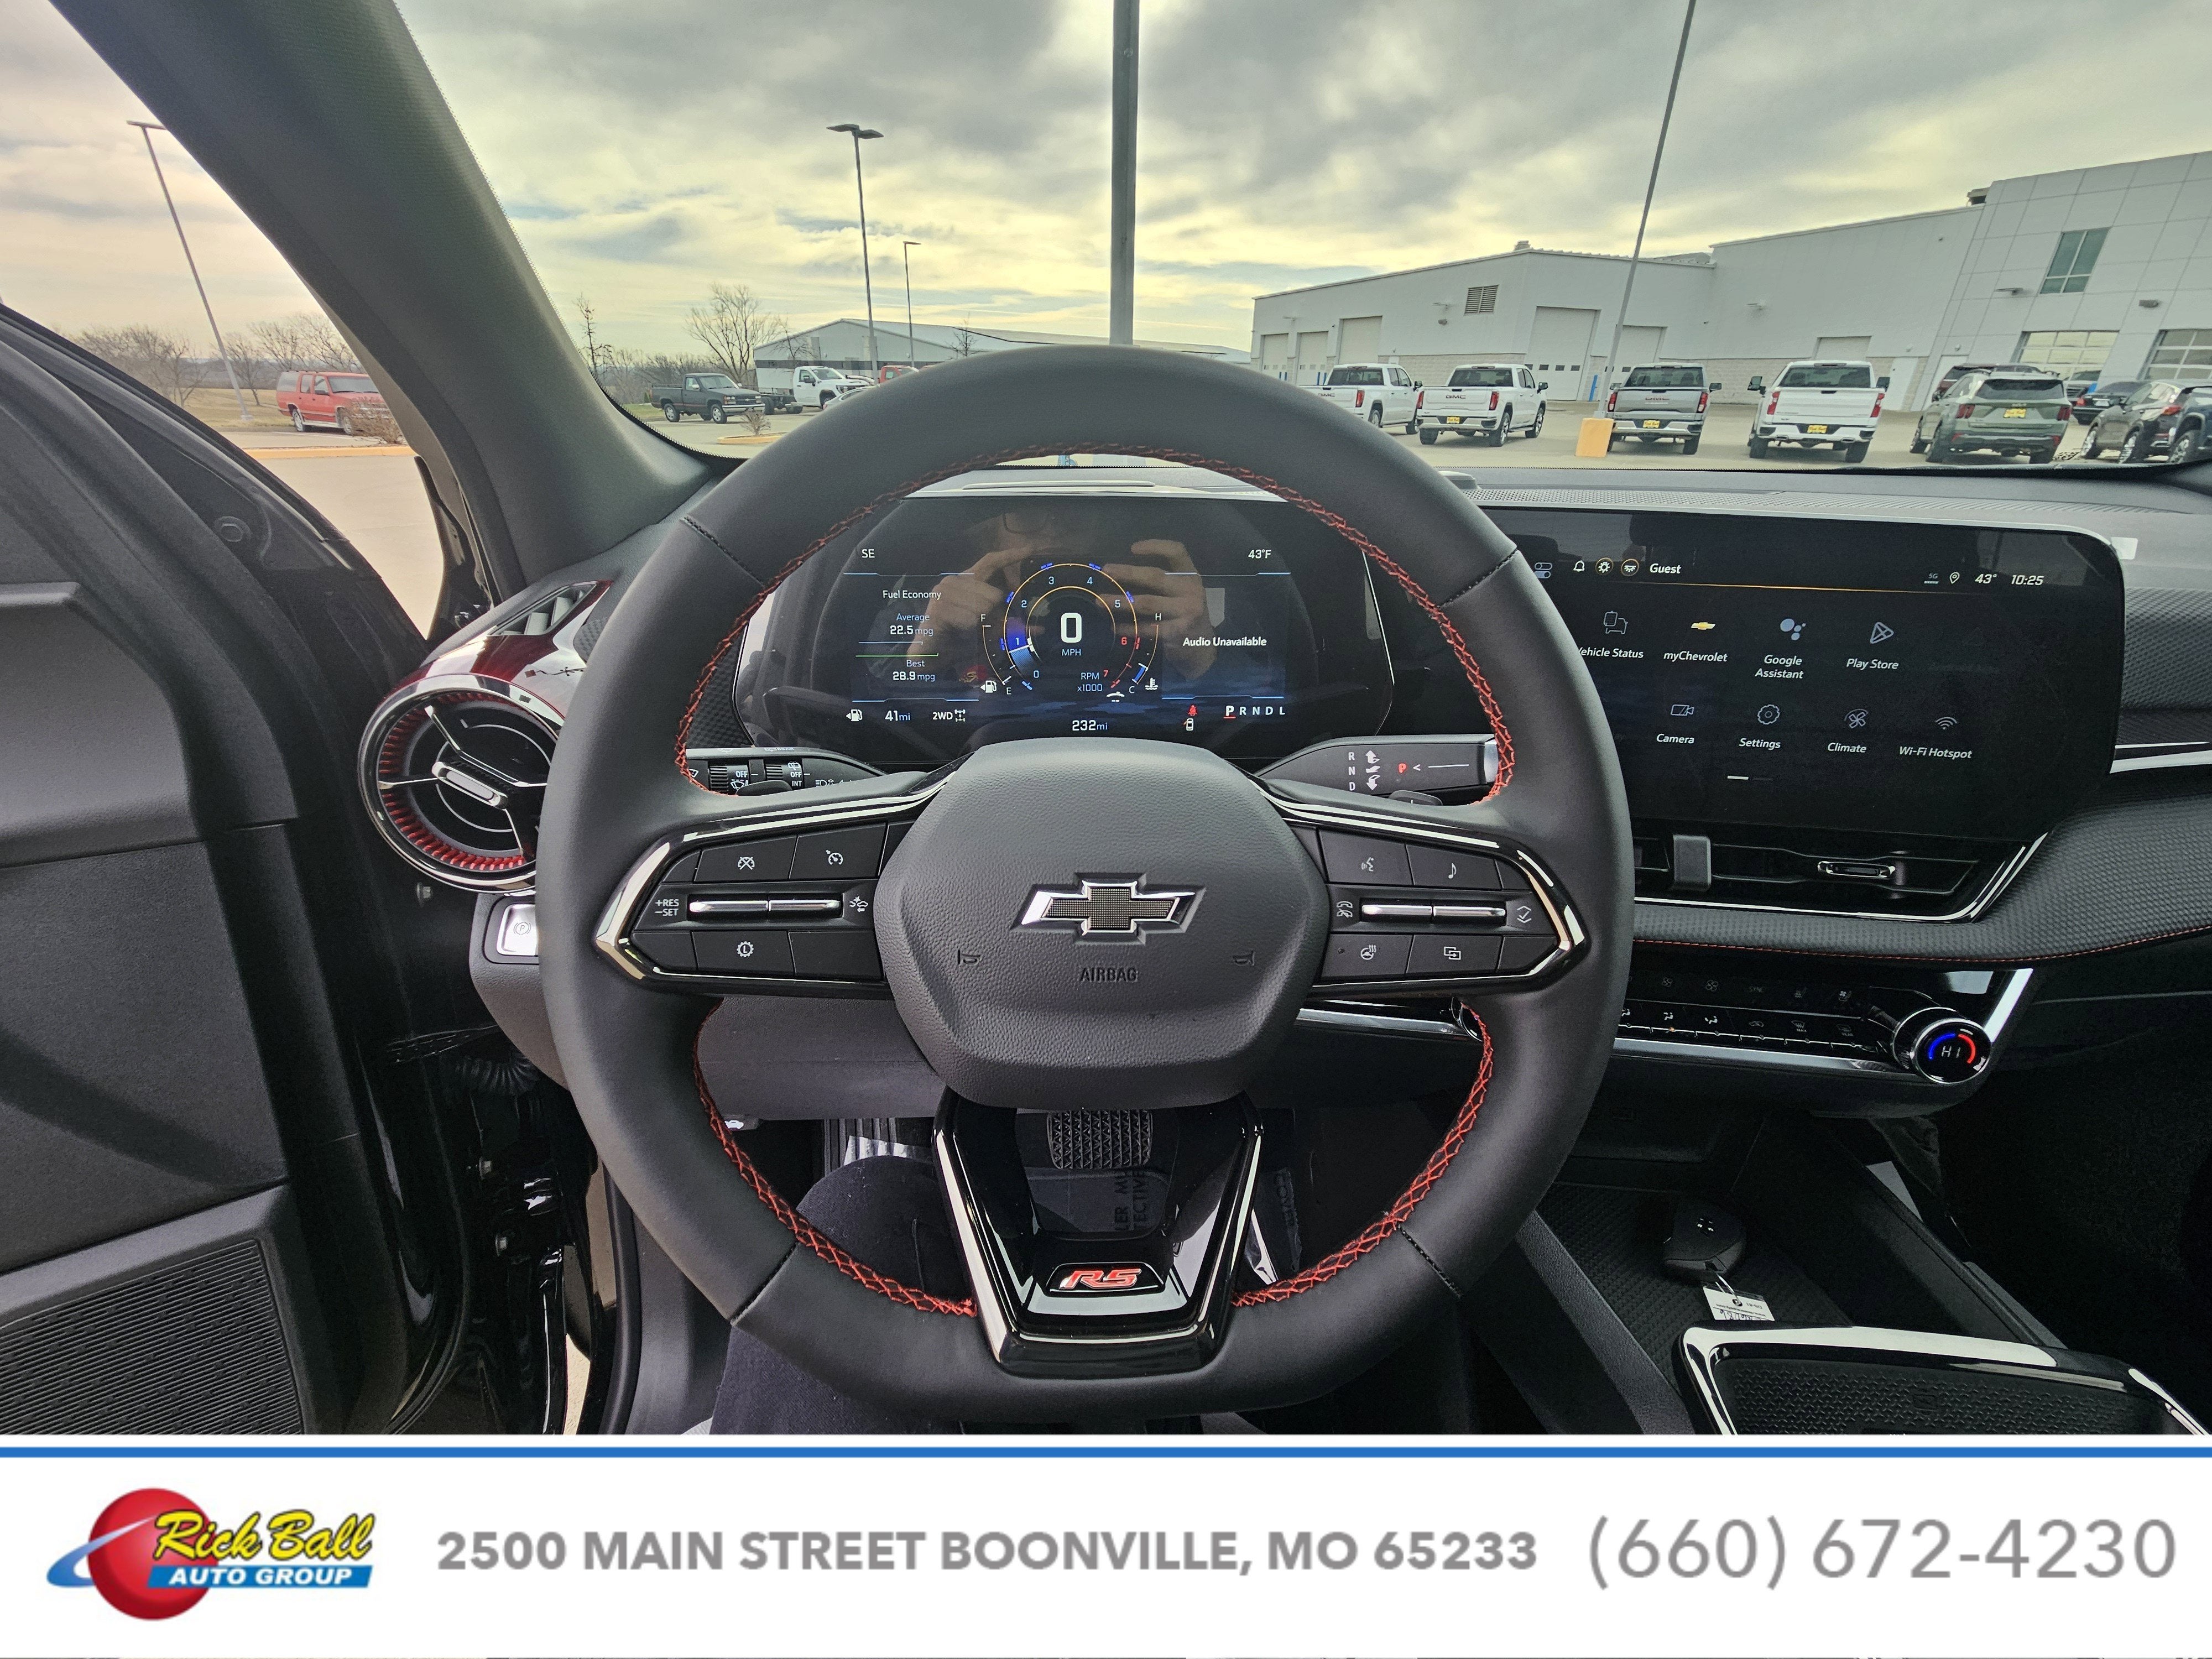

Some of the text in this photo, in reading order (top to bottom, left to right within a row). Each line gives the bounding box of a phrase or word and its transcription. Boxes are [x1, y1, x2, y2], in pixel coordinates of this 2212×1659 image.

[862, 549, 875, 558] SE
[1248, 549, 1271, 559] 43°F
[1650, 563, 1681, 574] Guest
[1975, 573, 2044, 586] 43° 10:25
[883, 590, 941, 600] Fuel Economy
[1115, 599, 1120, 608] 5
[896, 613, 930, 623] Average
[890, 625, 933, 637] 22.5 mpg
[1061, 612, 1082, 643] 0
[1121, 637, 1127, 645] 6
[1183, 637, 1267, 646] Audio Unavailable
[1612, 648, 1644, 658] Status
[1663, 651, 1728, 662] myChevrolet
[1764, 655, 1802, 667] Google
[1846, 658, 1899, 670] Play Store
[893, 671, 935, 682] 28.9 mpg
[1755, 668, 1804, 679] Assistant
[1077, 684, 1103, 692] x1000
[1656, 734, 1694, 744] Camera
[1739, 738, 1781, 750] Settings
[1827, 743, 1866, 753] Climate
[1899, 746, 1972, 760] Wi-Fi Hotspot
[1348, 752, 1355, 760] R
[1348, 766, 1355, 775] N
[1398, 763, 1406, 773] P
[1349, 782, 1355, 791] D
[1079, 967, 1138, 983] AIRBAG
[1059, 1268, 1141, 1289] RS
